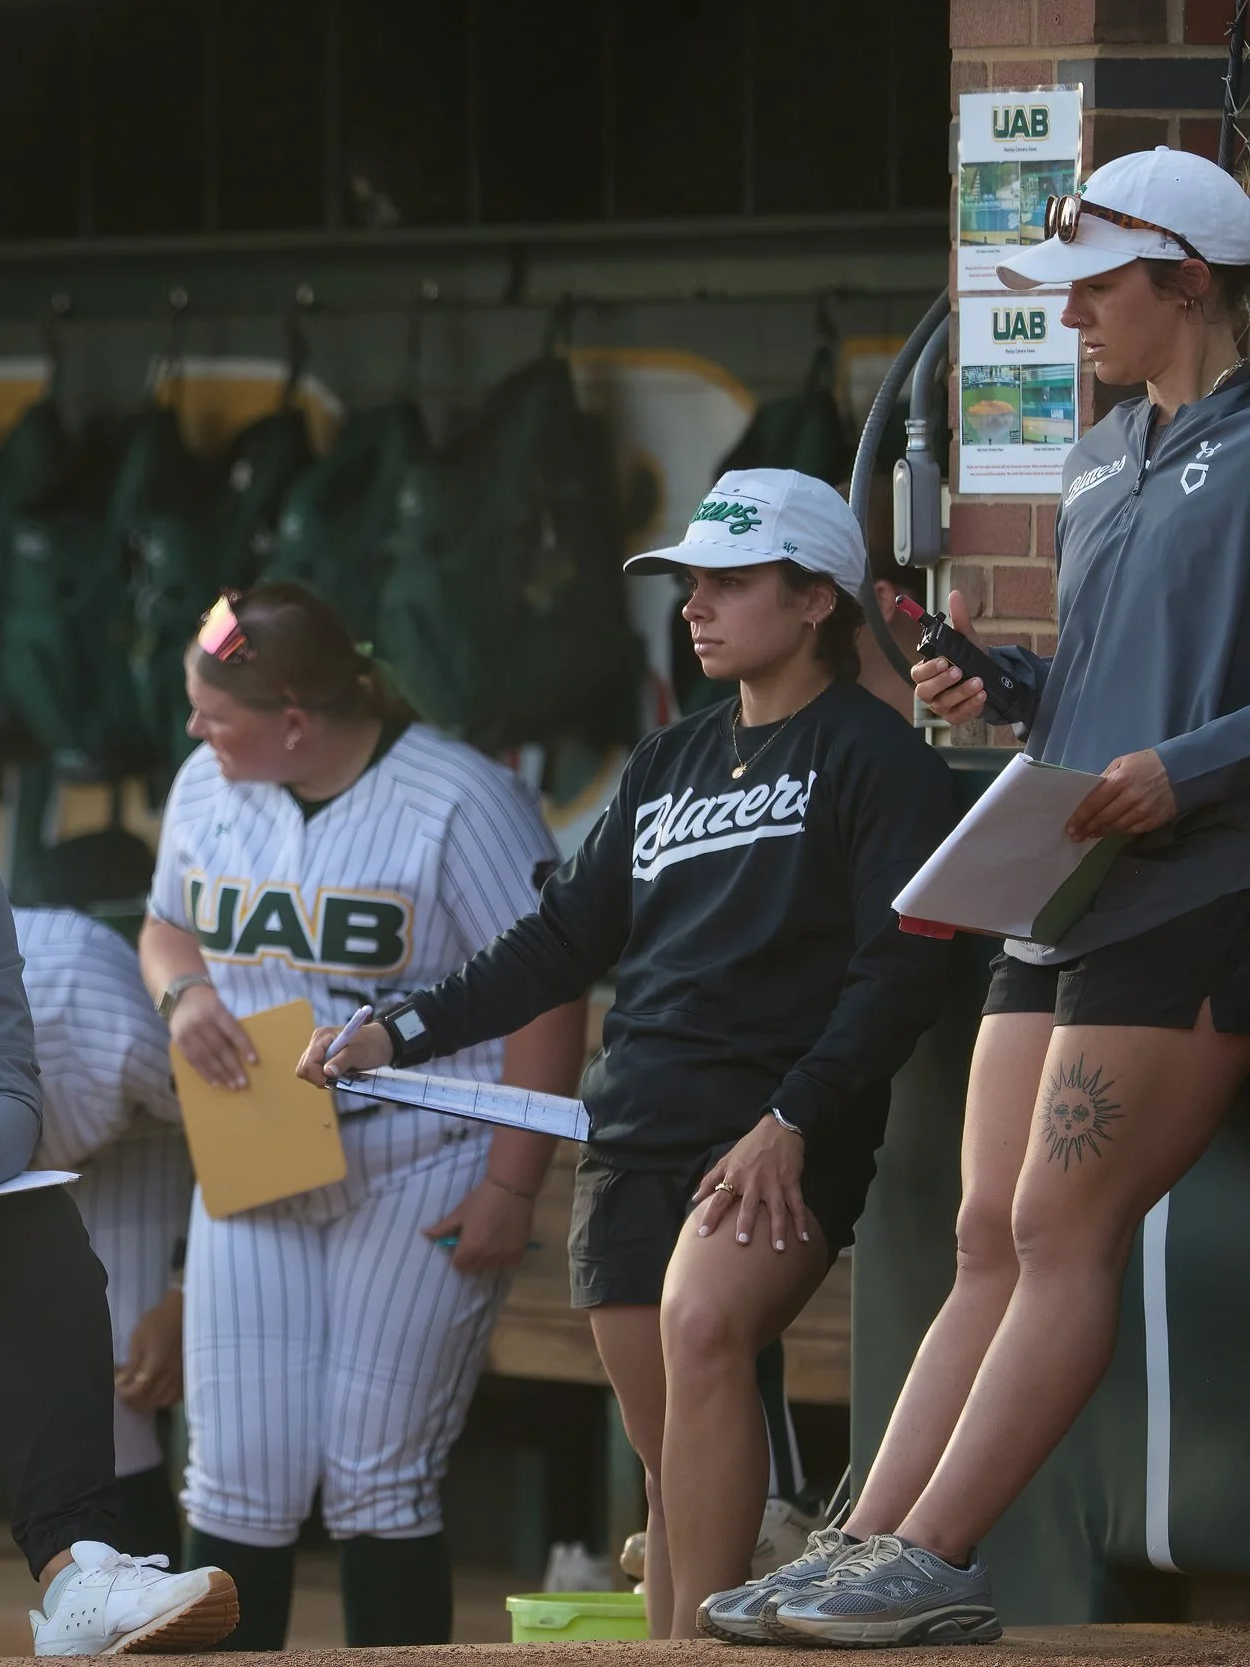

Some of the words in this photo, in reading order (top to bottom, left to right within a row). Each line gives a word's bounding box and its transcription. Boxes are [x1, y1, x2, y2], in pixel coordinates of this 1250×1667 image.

[992, 106, 1049, 140] UAB
[992, 309, 1046, 342] UAB
[187, 874, 412, 972] UAB
